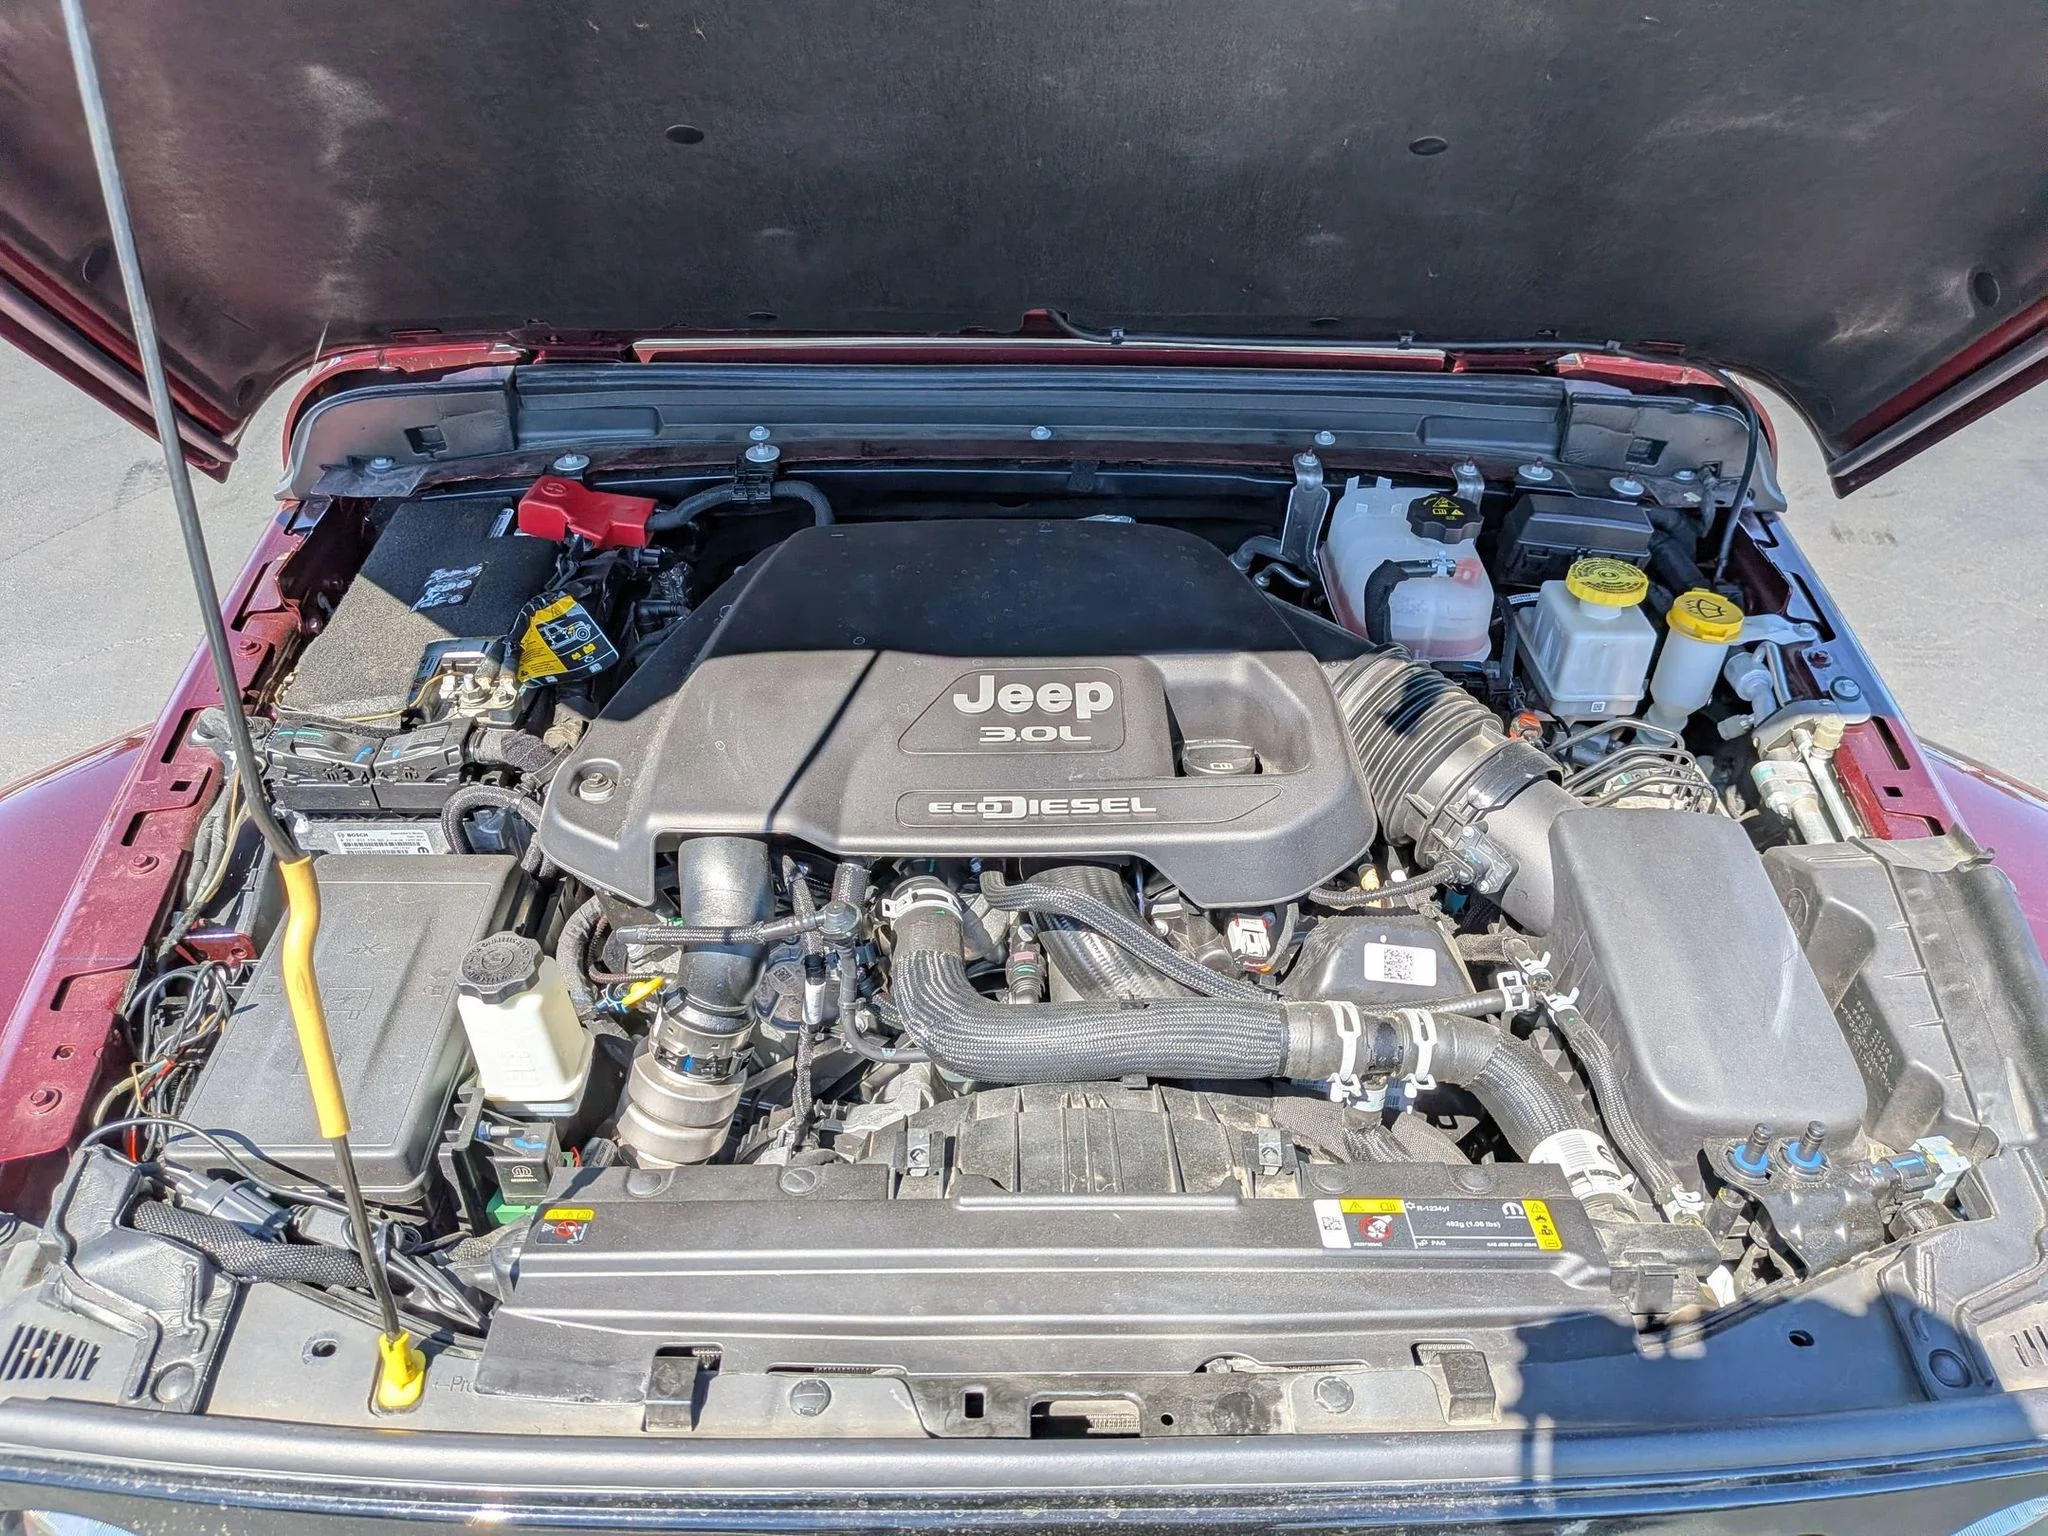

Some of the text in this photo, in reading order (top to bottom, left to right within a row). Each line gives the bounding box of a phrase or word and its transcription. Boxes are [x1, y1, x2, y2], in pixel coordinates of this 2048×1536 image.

[953, 675, 1113, 720] Jeep
[979, 726, 1092, 743] 3.0L
[1416, 1205, 1450, 1213] R-1234yf
[1485, 1221, 1501, 1229] lbs)
